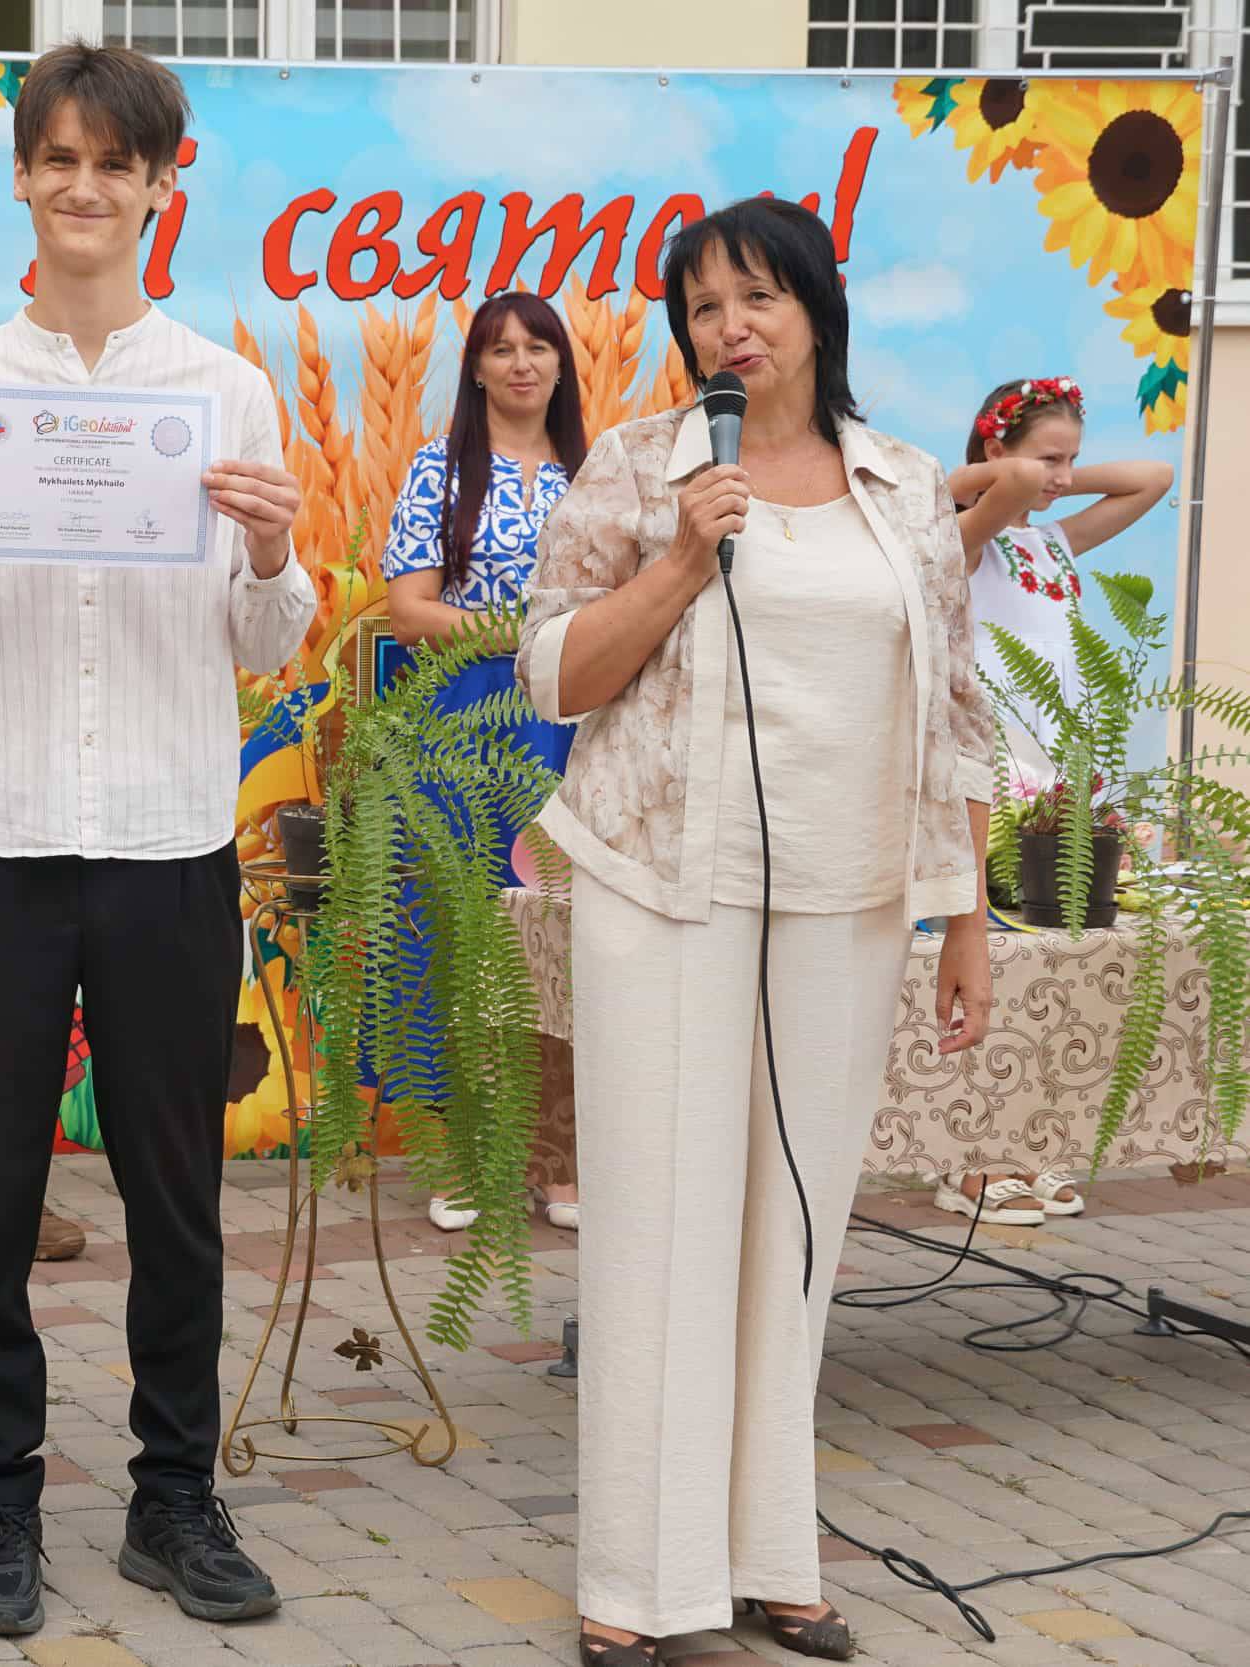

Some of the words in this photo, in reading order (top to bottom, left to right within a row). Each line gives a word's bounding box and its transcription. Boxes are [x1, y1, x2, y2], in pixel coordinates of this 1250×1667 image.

[262, 126, 879, 301] свято!
[53, 455, 111, 467] CERTIFICATE
[38, 476, 85, 486] Mykhailets
[86, 478, 125, 488] Mykhailo
